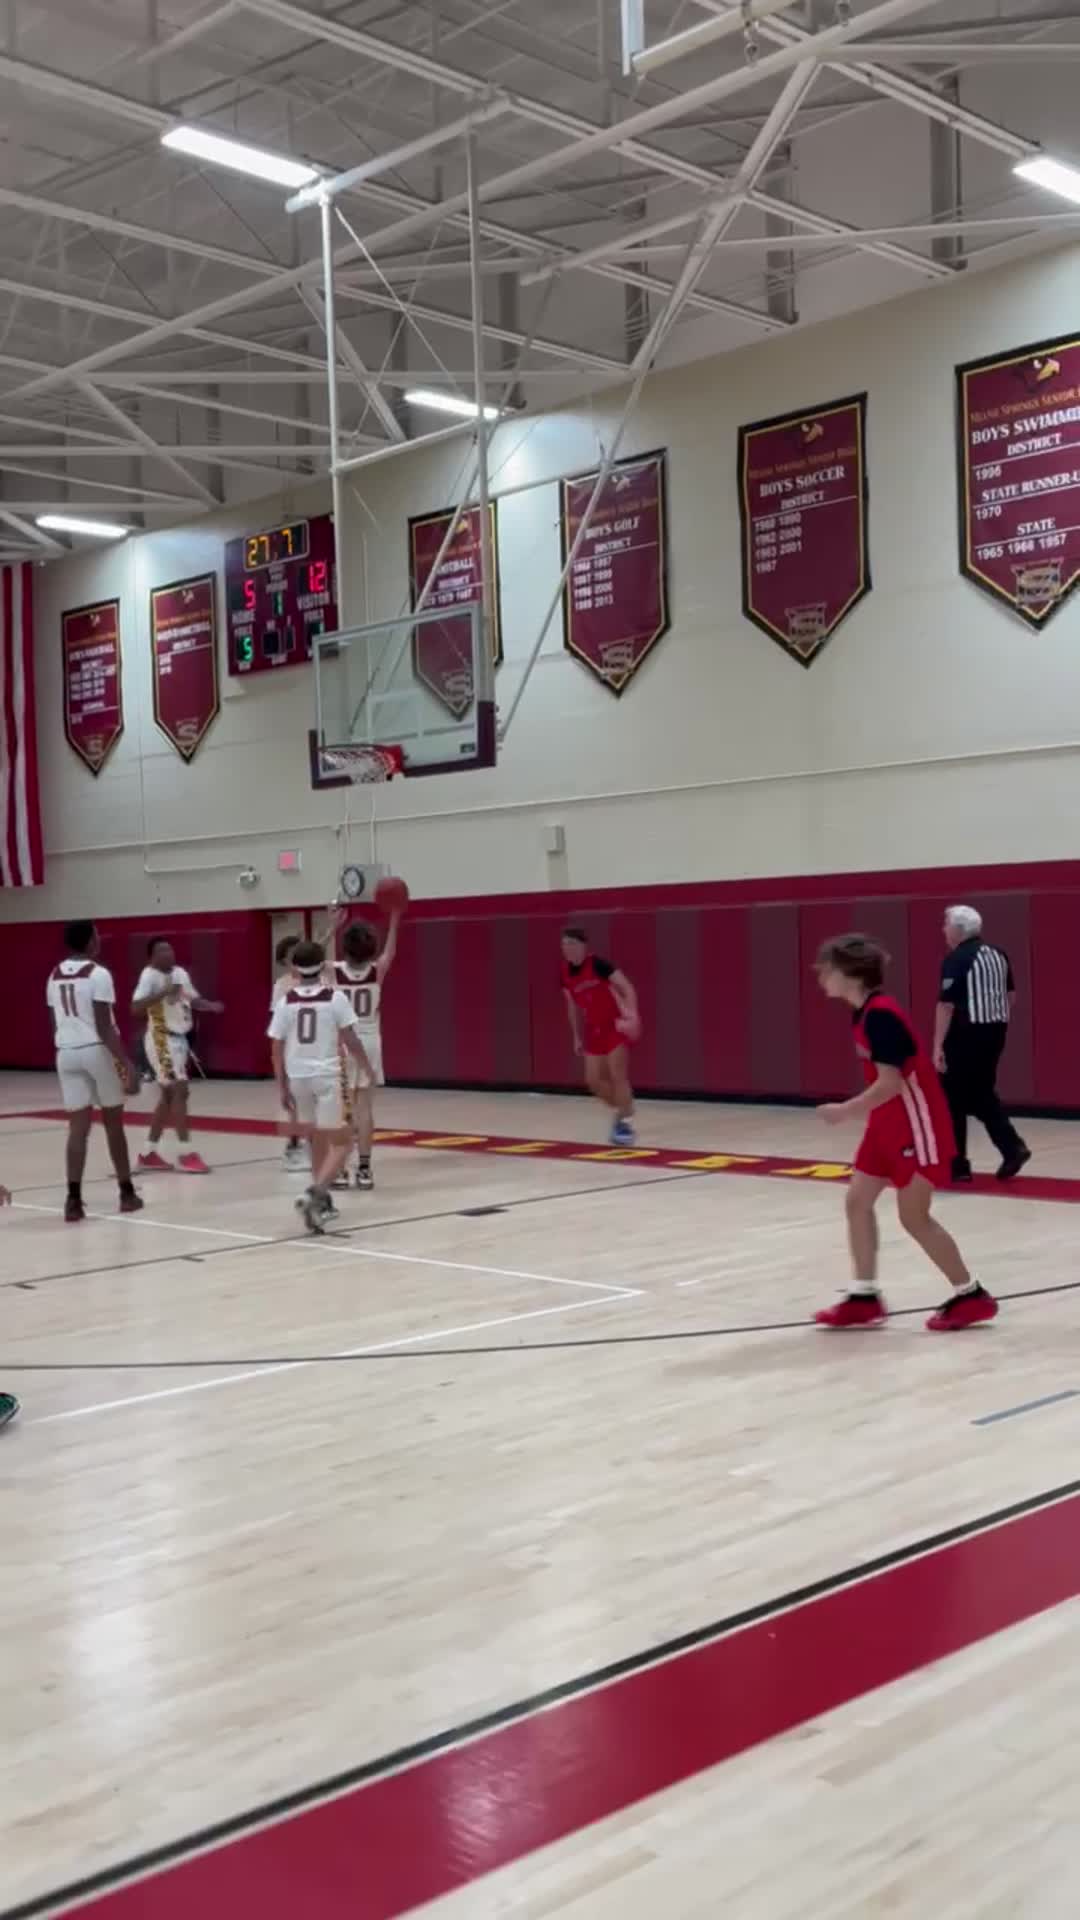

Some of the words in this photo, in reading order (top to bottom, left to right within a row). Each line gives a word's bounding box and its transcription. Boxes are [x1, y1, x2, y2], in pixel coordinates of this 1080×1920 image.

[972, 423, 1009, 445] BOYS
[1007, 432, 1061, 456] DISTRICT
[760, 477, 793, 497] BOYS
[796, 464, 845, 488] SOCCER
[781, 490, 825, 510] DISTRICT
[982, 484, 1019, 502] STATE
[976, 505, 1001, 521] 1970
[585, 523, 612, 539] BOYS
[614, 515, 640, 533] GOLF
[1017, 518, 1055, 535] STATE
[309, 561, 325, 593] 12
[244, 579, 256, 609] 5
[297, 592, 329, 611] VISITOR
[243, 637, 253, 660] 5
[59, 983, 79, 1017] 11
[298, 1008, 317, 1044] 0
